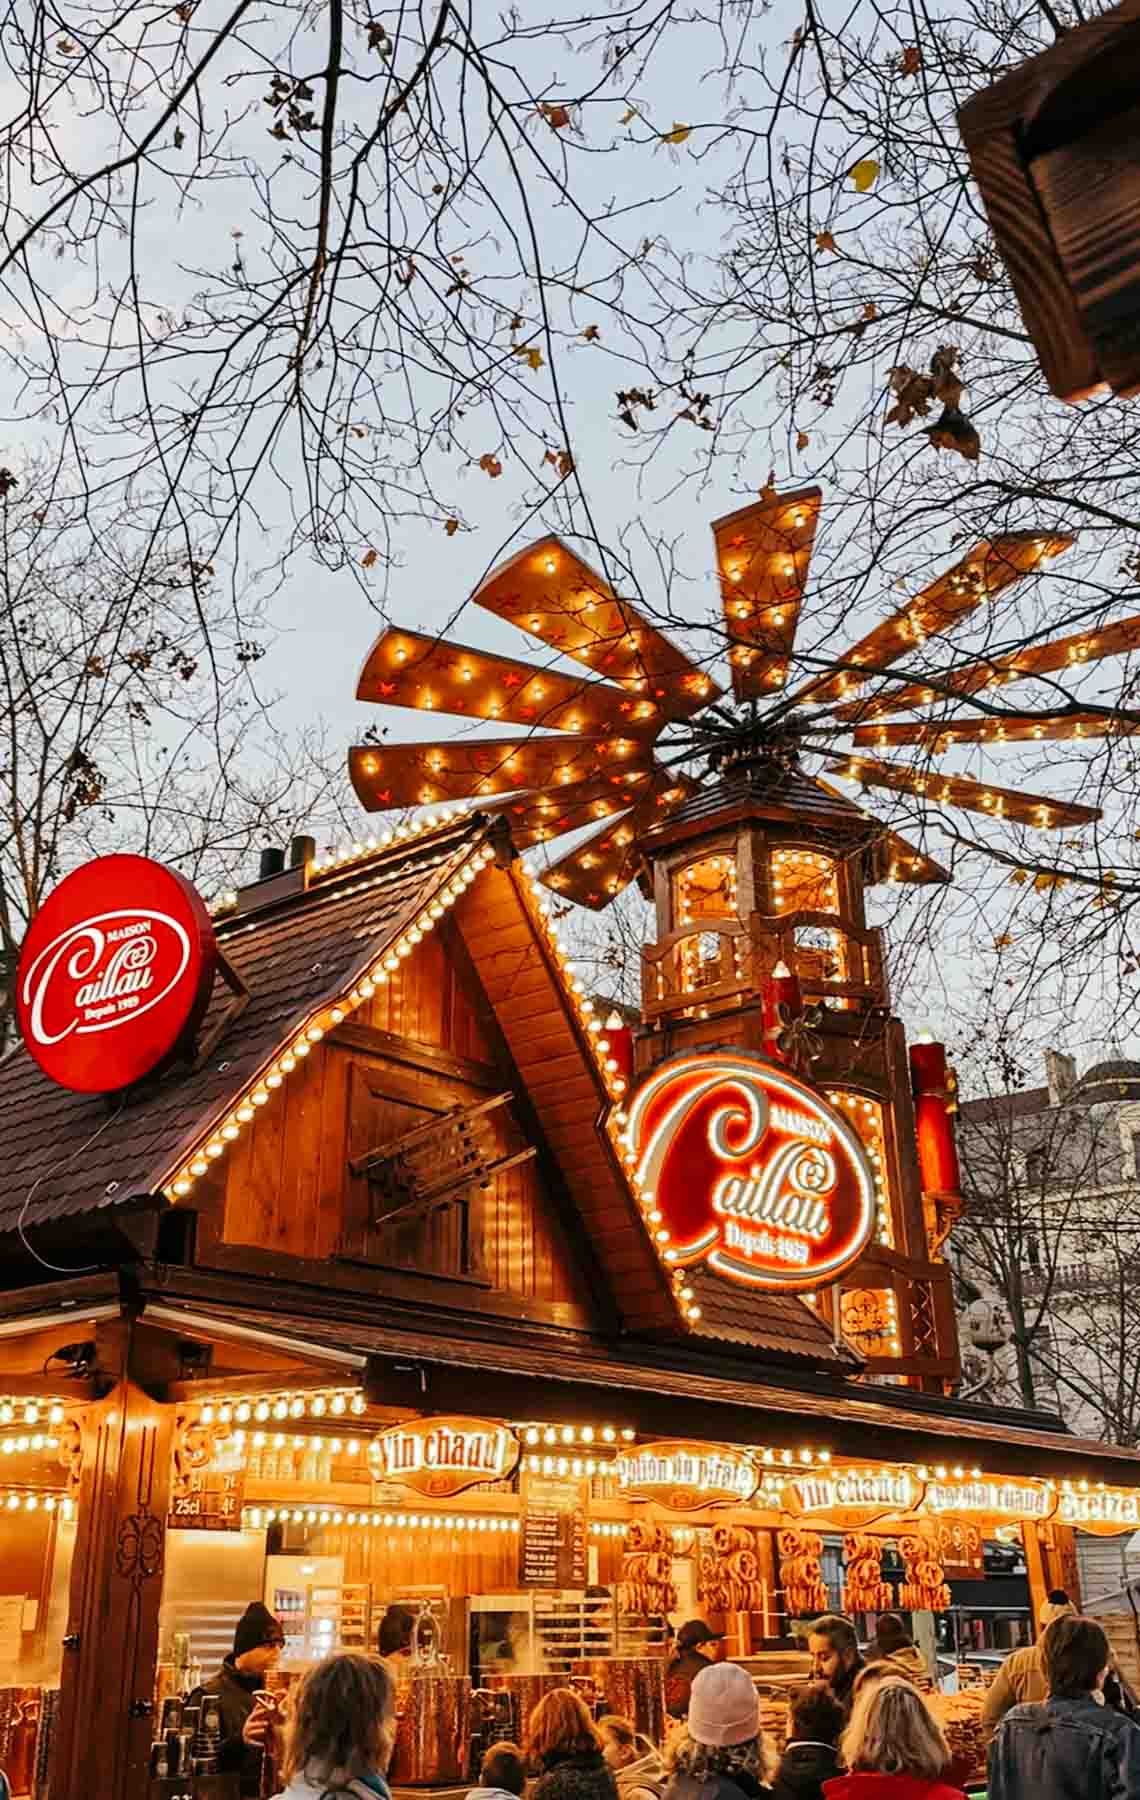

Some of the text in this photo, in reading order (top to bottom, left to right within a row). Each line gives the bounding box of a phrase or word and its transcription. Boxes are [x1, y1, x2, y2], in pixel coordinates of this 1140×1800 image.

[106, 920, 152, 943] MAISON
[31, 927, 158, 1045] Caillau
[84, 1002, 117, 1021] Depuis
[769, 1105, 832, 1144] MAISON
[637, 1073, 836, 1260] Caillau
[725, 1221, 777, 1257] Depuis
[423, 1429, 500, 1471] chaud
[175, 1498, 200, 1515] 25cl
[834, 1474, 906, 1506] chaud
[1060, 1493, 1140, 1521] Bretze
